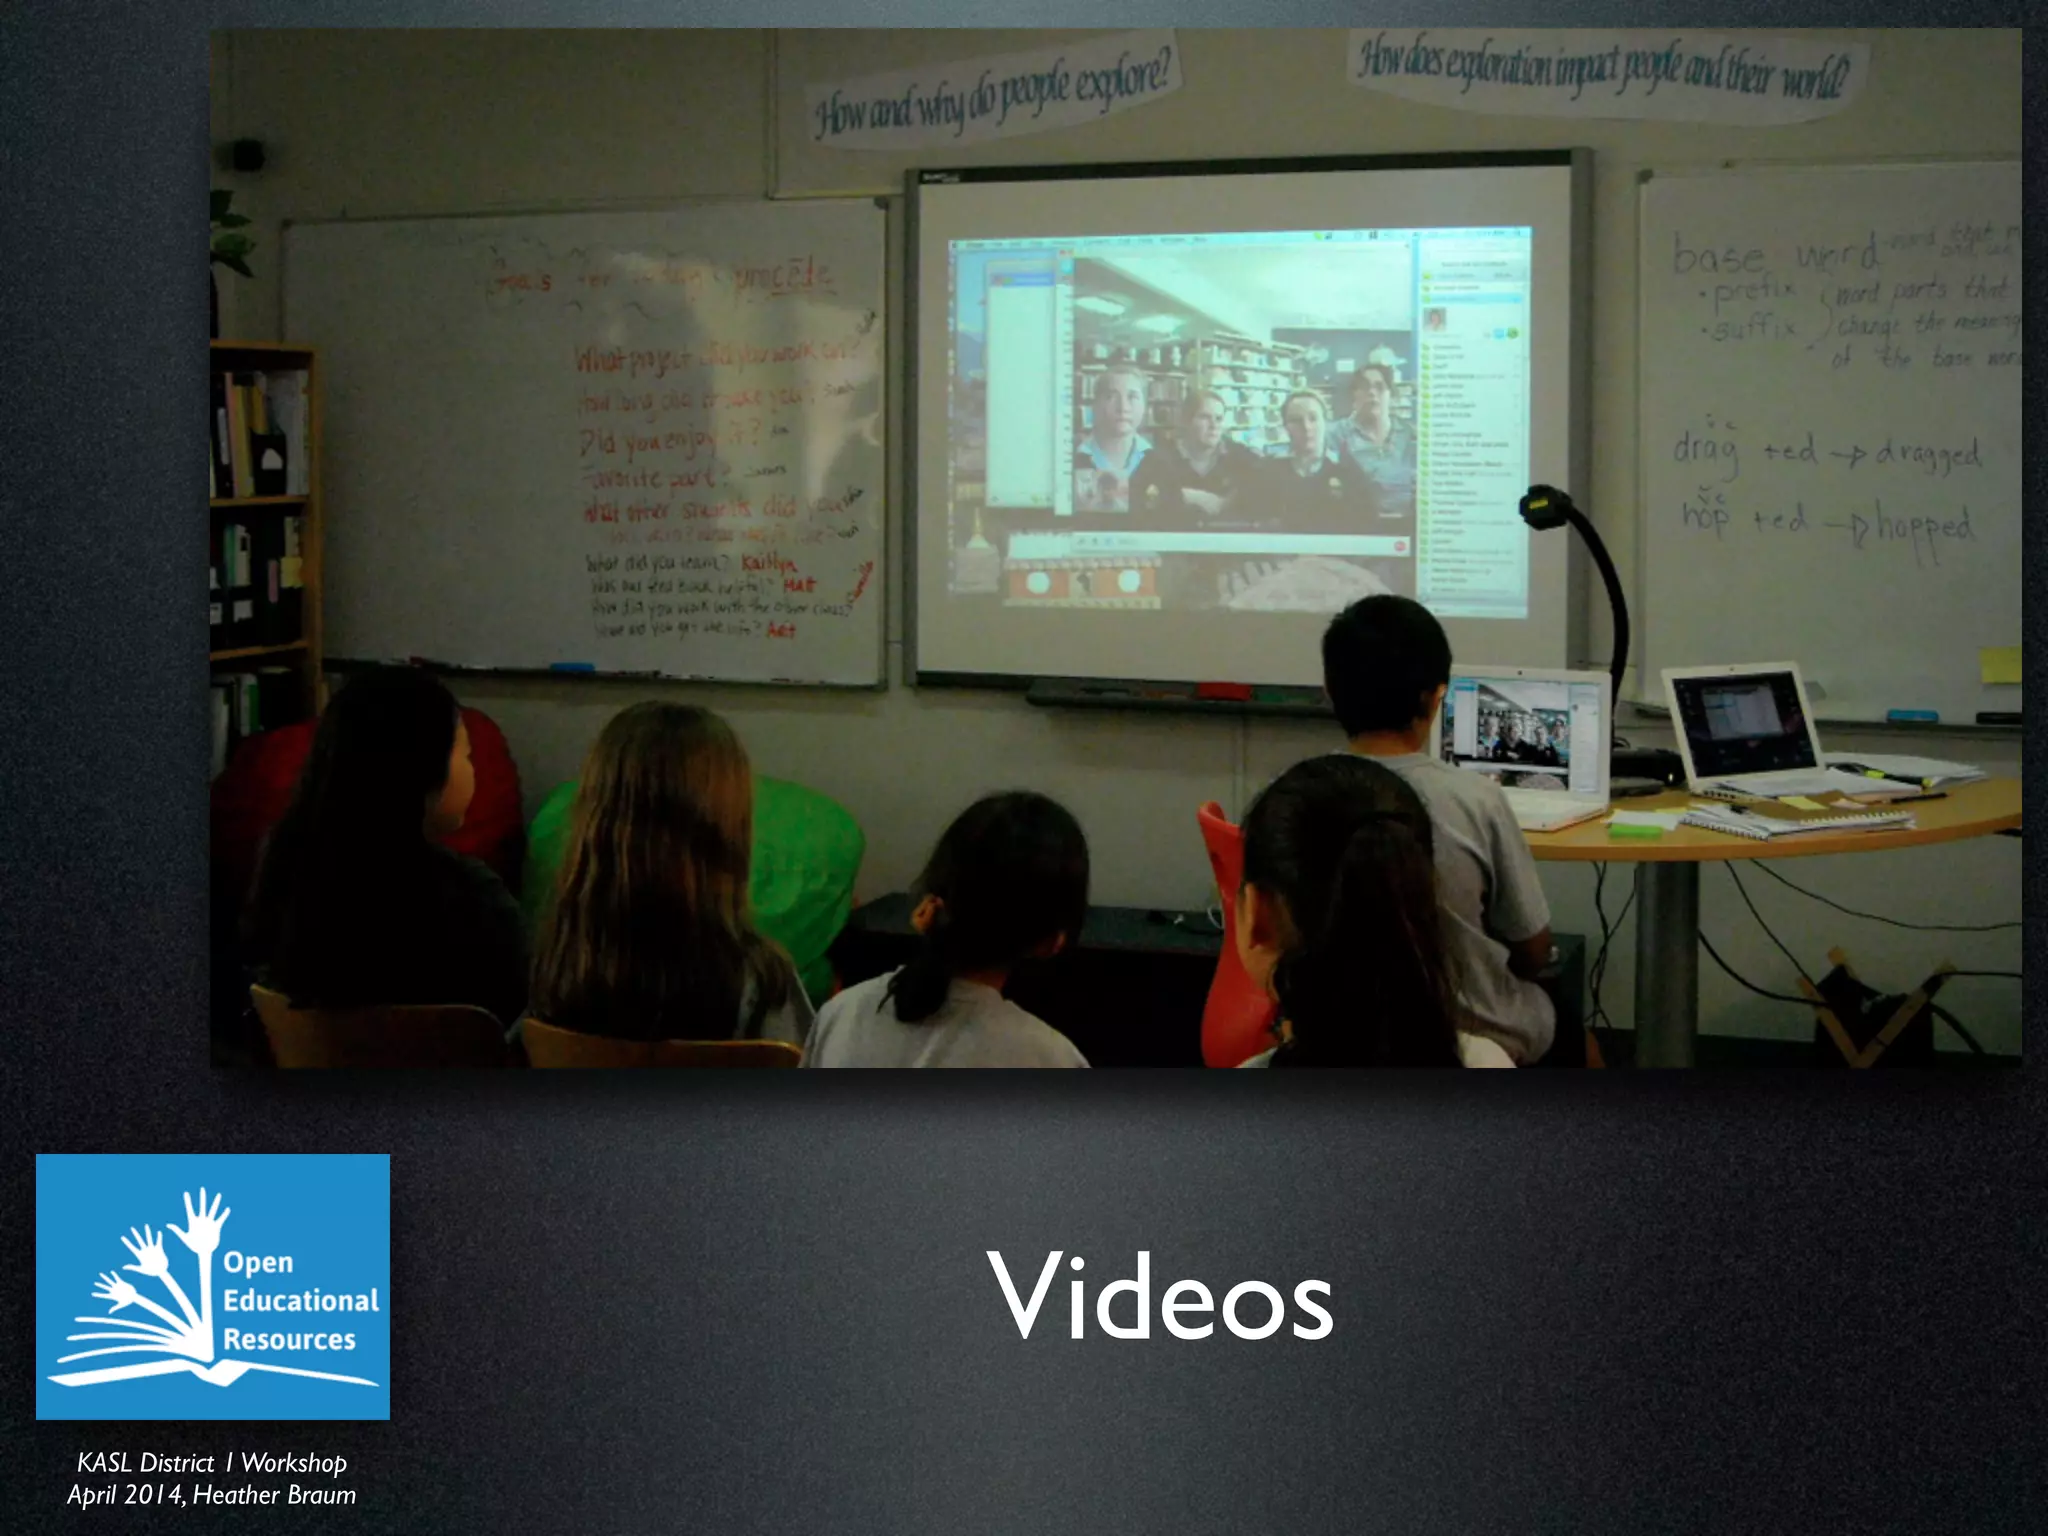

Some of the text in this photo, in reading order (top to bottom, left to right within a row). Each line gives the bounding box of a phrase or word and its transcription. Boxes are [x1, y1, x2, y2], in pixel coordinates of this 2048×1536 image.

[1357, 31, 1851, 101] How does exploration impact people and their world?
[814, 45, 1172, 141] How and why do people explore?
[1673, 230, 1883, 274] base word
[1714, 271, 1797, 316] prefix
[1890, 270, 1947, 314] parts
[1965, 272, 2012, 299] that
[1711, 311, 1796, 342] suffix
[1932, 344, 1973, 368] base
[1876, 436, 1984, 479] dragged
[1875, 498, 1978, 570] hopped
